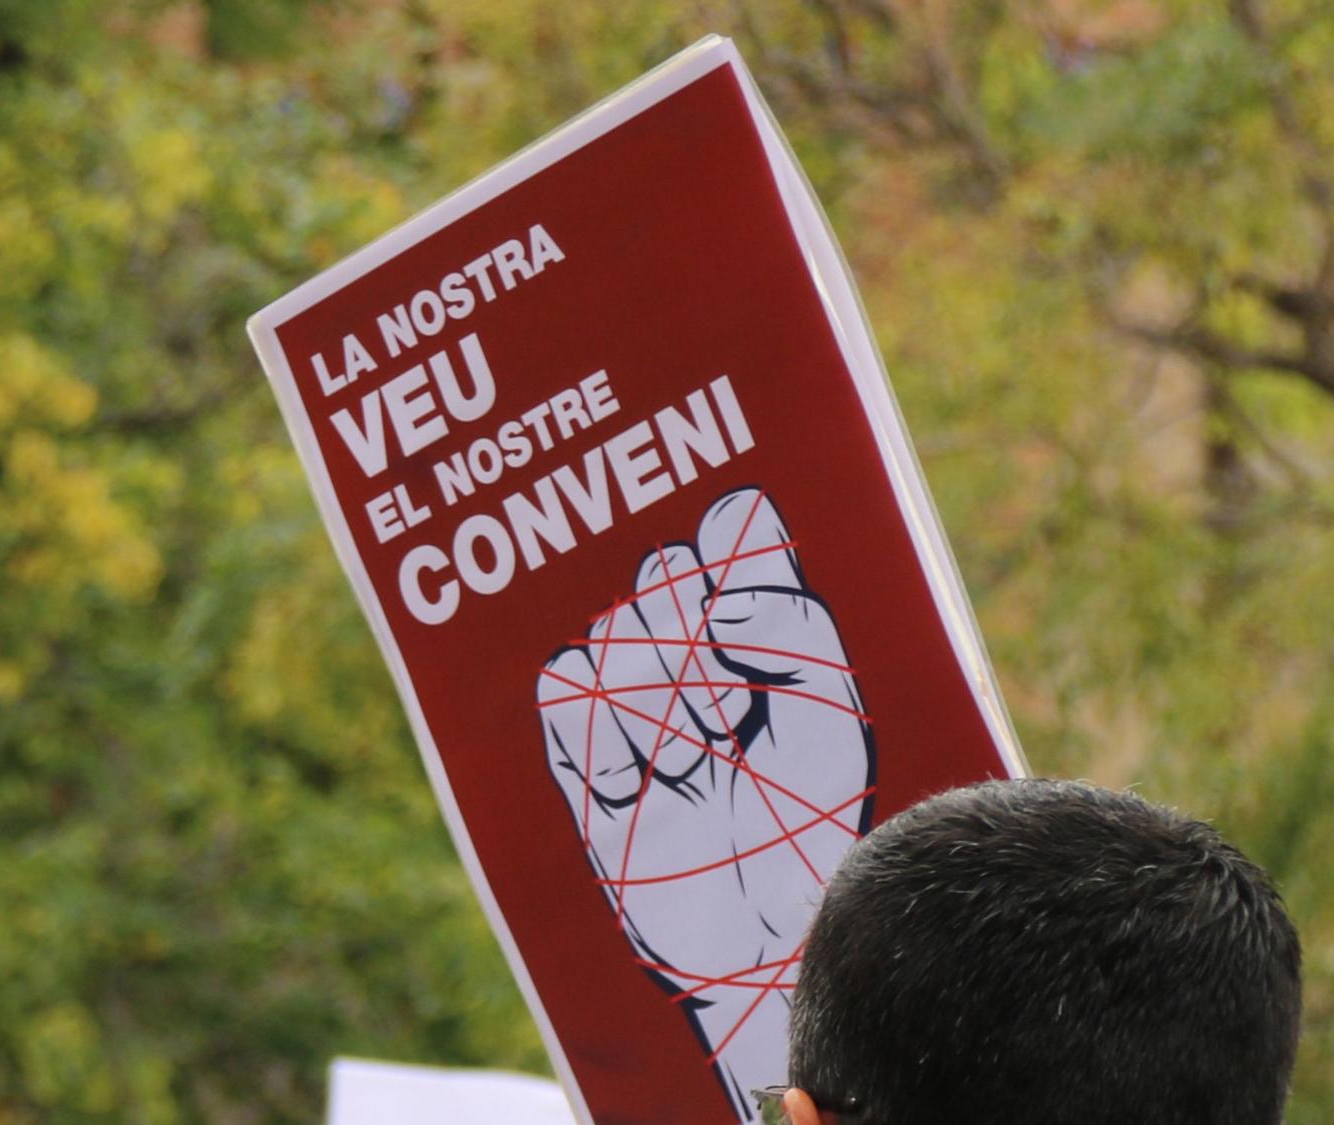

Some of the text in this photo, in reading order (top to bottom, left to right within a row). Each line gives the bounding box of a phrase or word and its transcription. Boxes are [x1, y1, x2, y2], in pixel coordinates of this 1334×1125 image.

[311, 224, 565, 396] LA NOSTRA
[329, 333, 496, 478] VEU
[365, 369, 620, 544] EL NOSTRE
[398, 374, 755, 625] CONVENI
